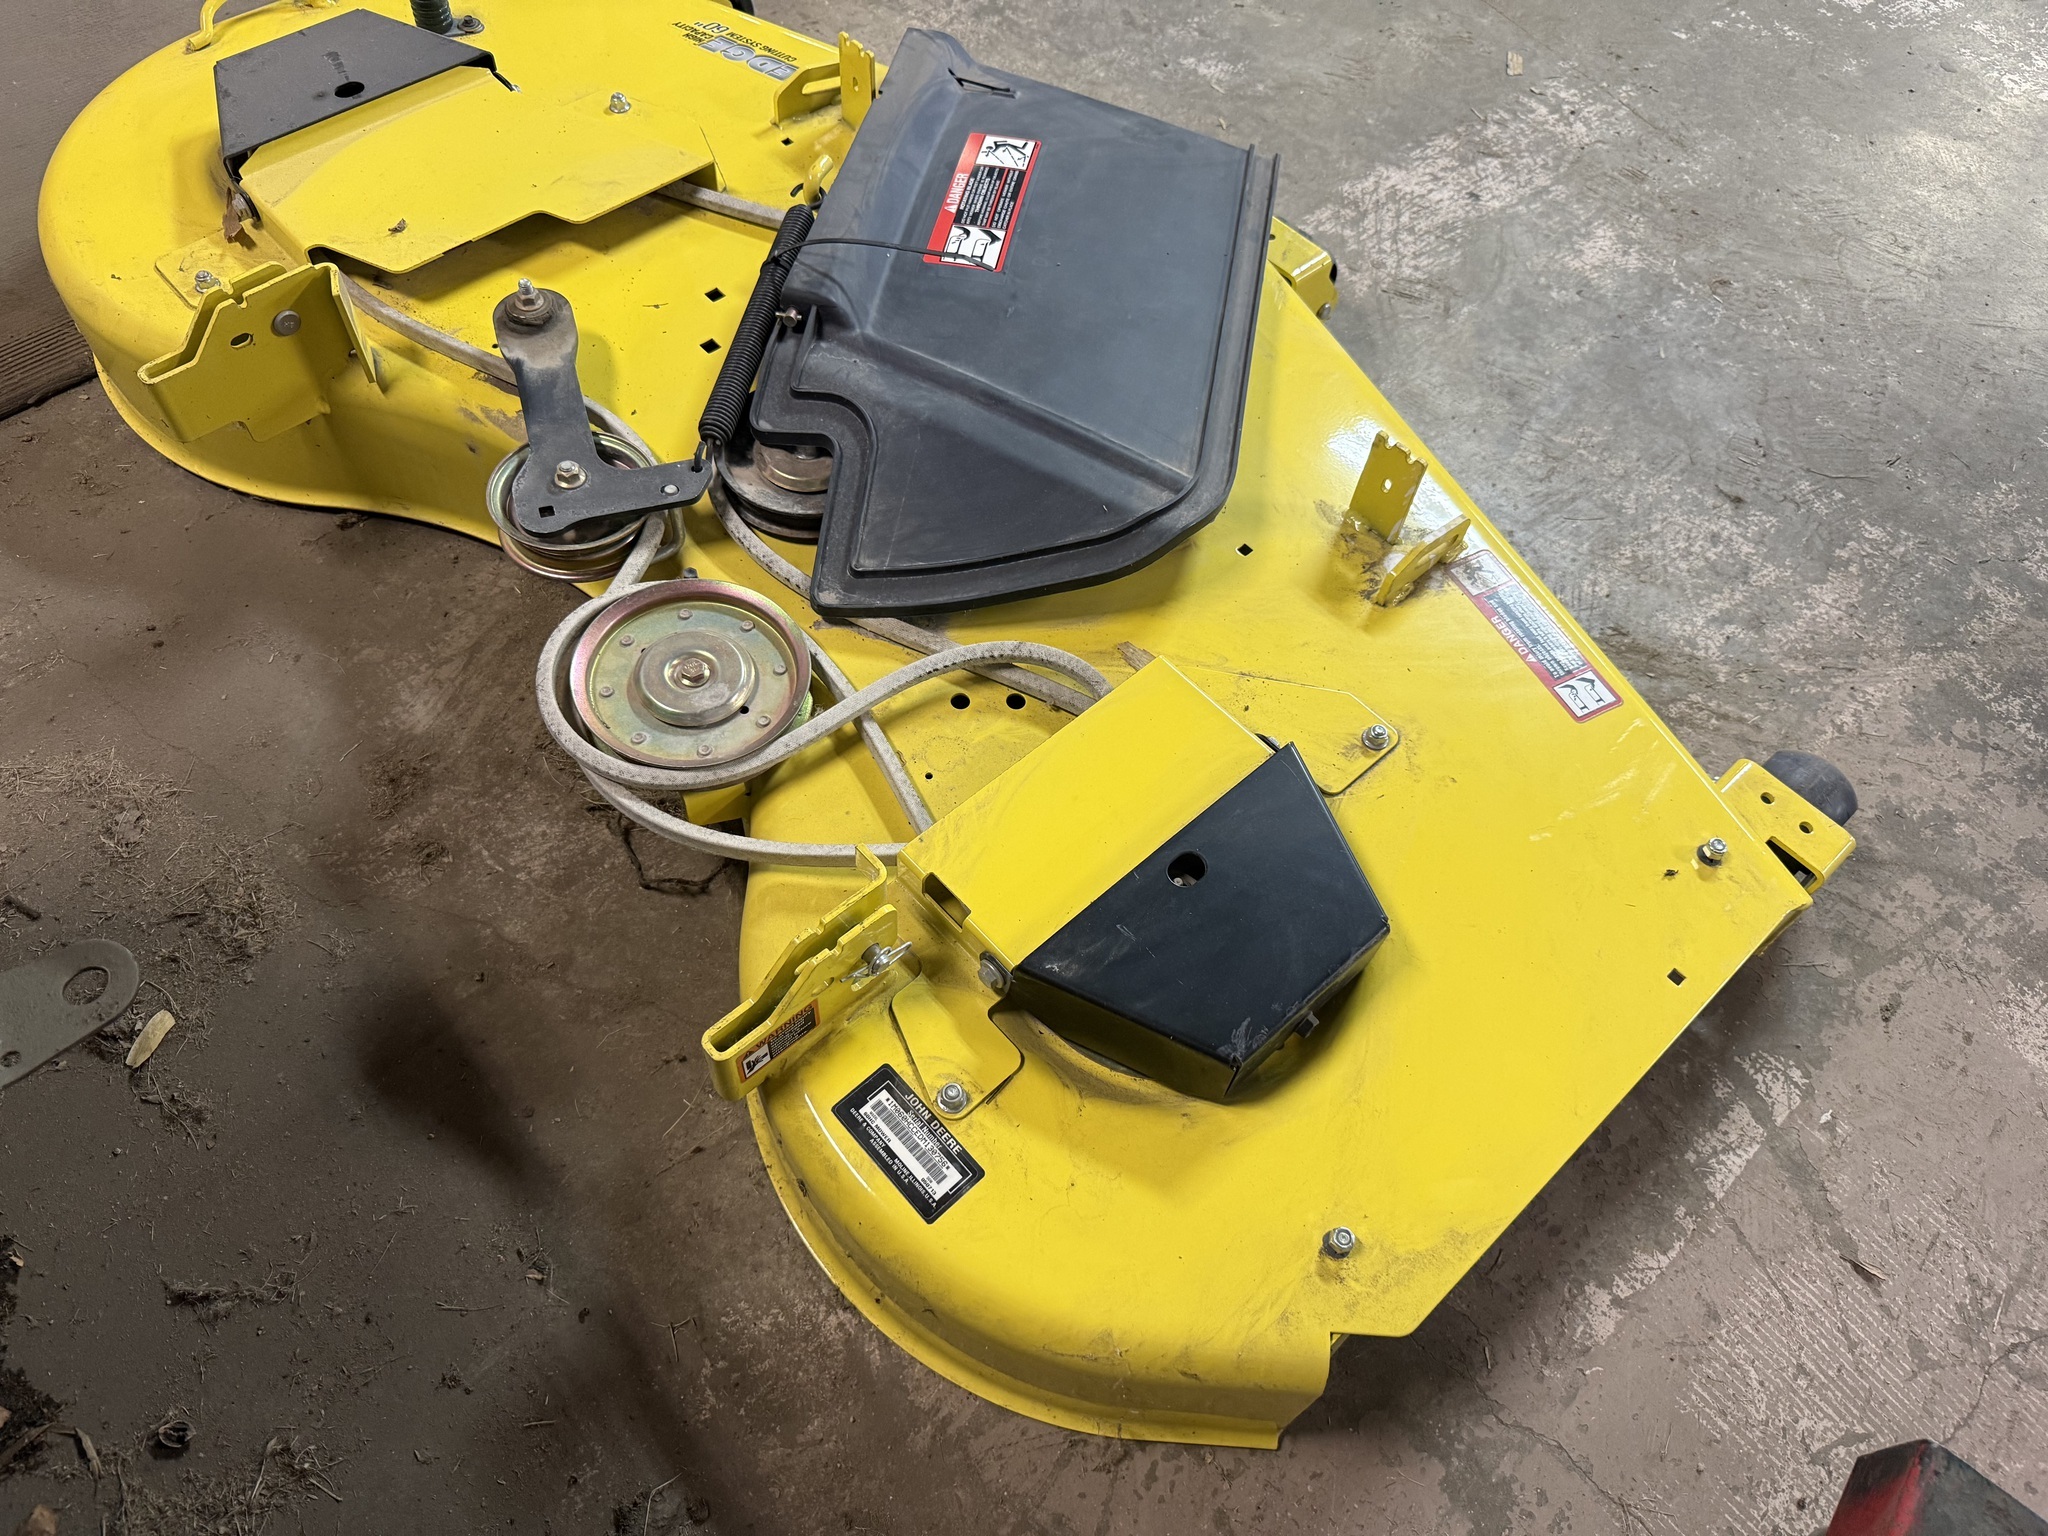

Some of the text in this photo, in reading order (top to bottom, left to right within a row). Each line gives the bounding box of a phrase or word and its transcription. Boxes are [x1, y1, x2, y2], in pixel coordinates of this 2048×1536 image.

[672, 21, 714, 40] CAPACITY
[727, 32, 761, 47] SYSTEM
[699, 35, 799, 81] EDGE
[761, 45, 797, 62] CUTTING
[946, 173, 969, 205] DANGER
[1490, 615, 1529, 655] DANGER
[756, 1003, 813, 1048] WARNING
[849, 1107, 863, 1122] DEERE
[865, 1126, 885, 1148] COMPANY
[904, 1091, 962, 1154] JOHN DEERE
[906, 1109, 942, 1149] Serial Number
[869, 1138, 892, 1164] ASSEMBLED
